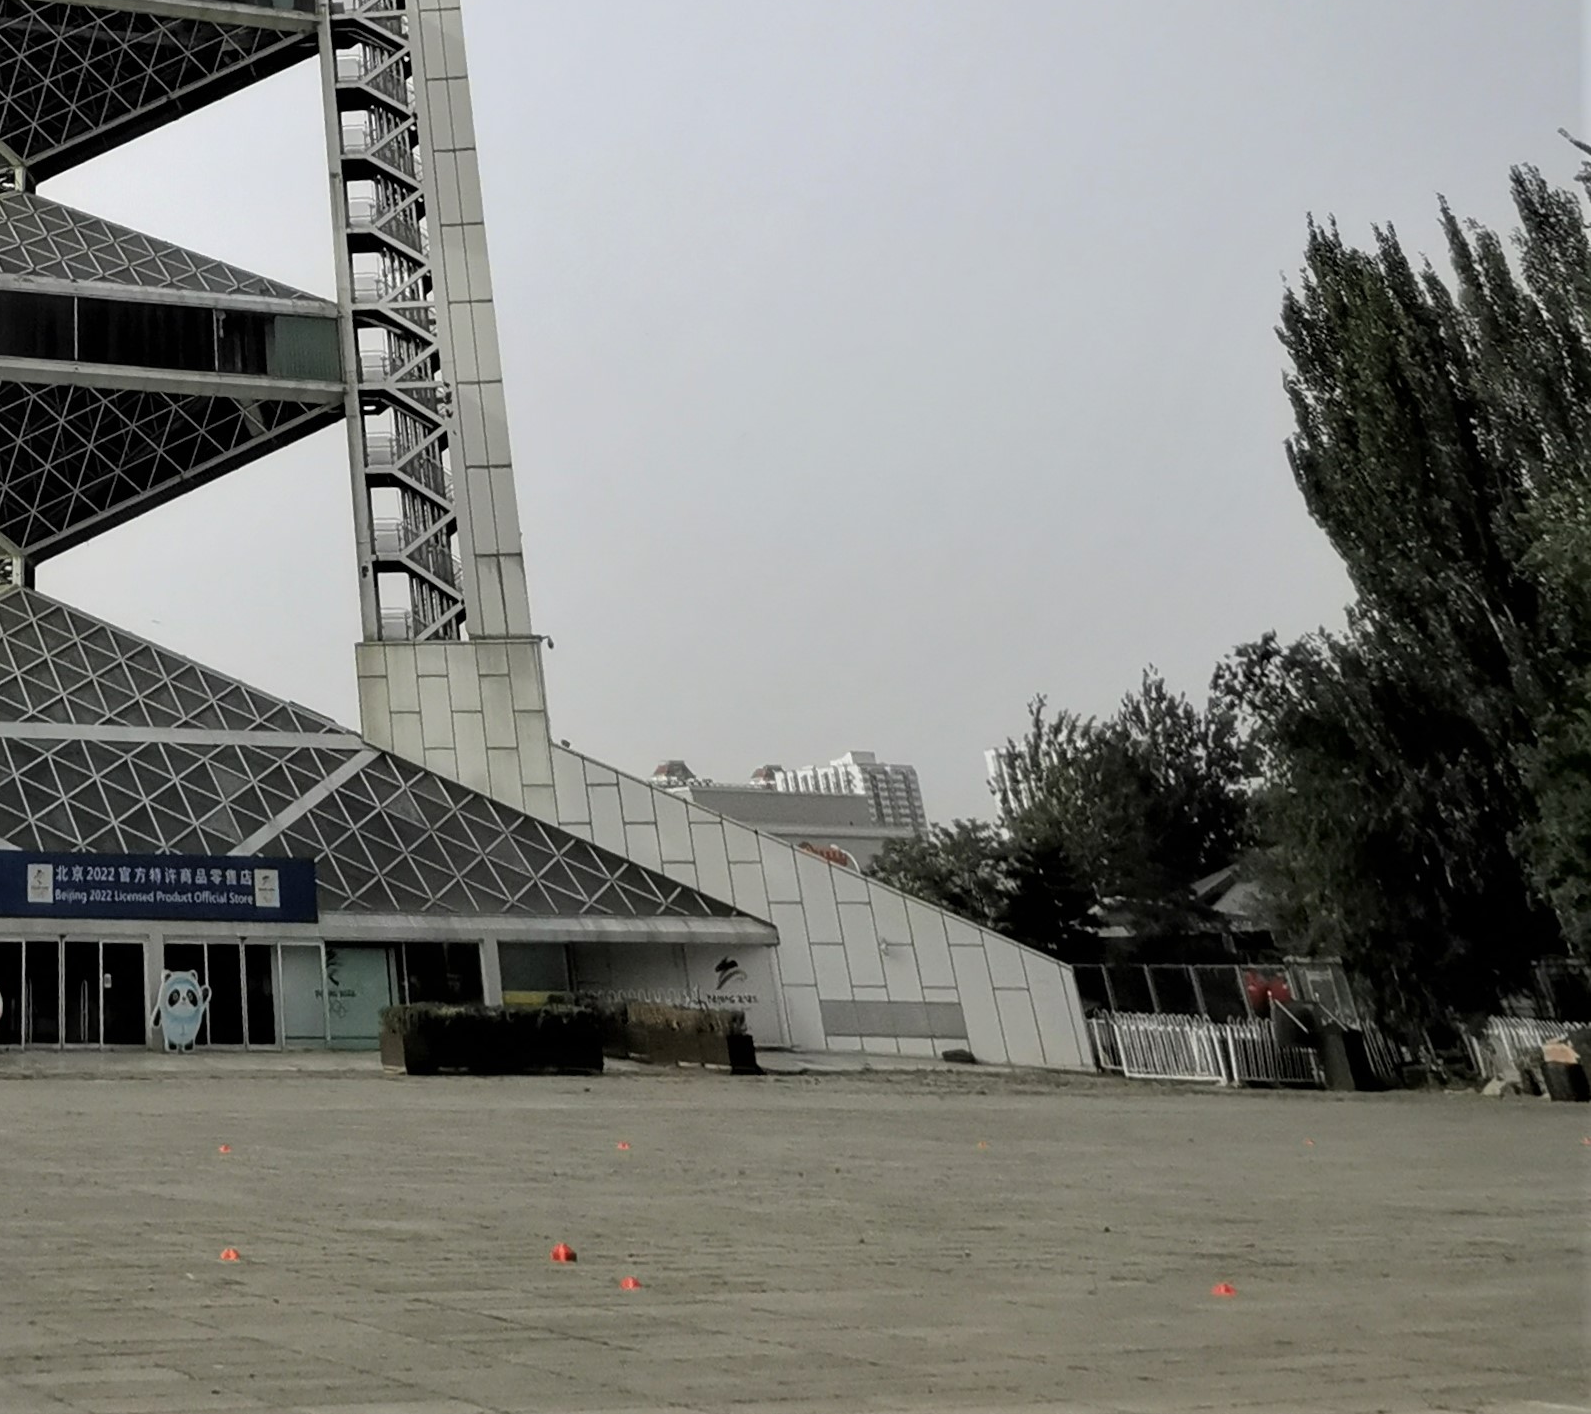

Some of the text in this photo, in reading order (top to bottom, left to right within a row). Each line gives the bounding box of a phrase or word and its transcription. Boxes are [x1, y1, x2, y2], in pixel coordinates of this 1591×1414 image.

[55, 888, 253, 905] Beijing 2022 Licensed Product Official Store
